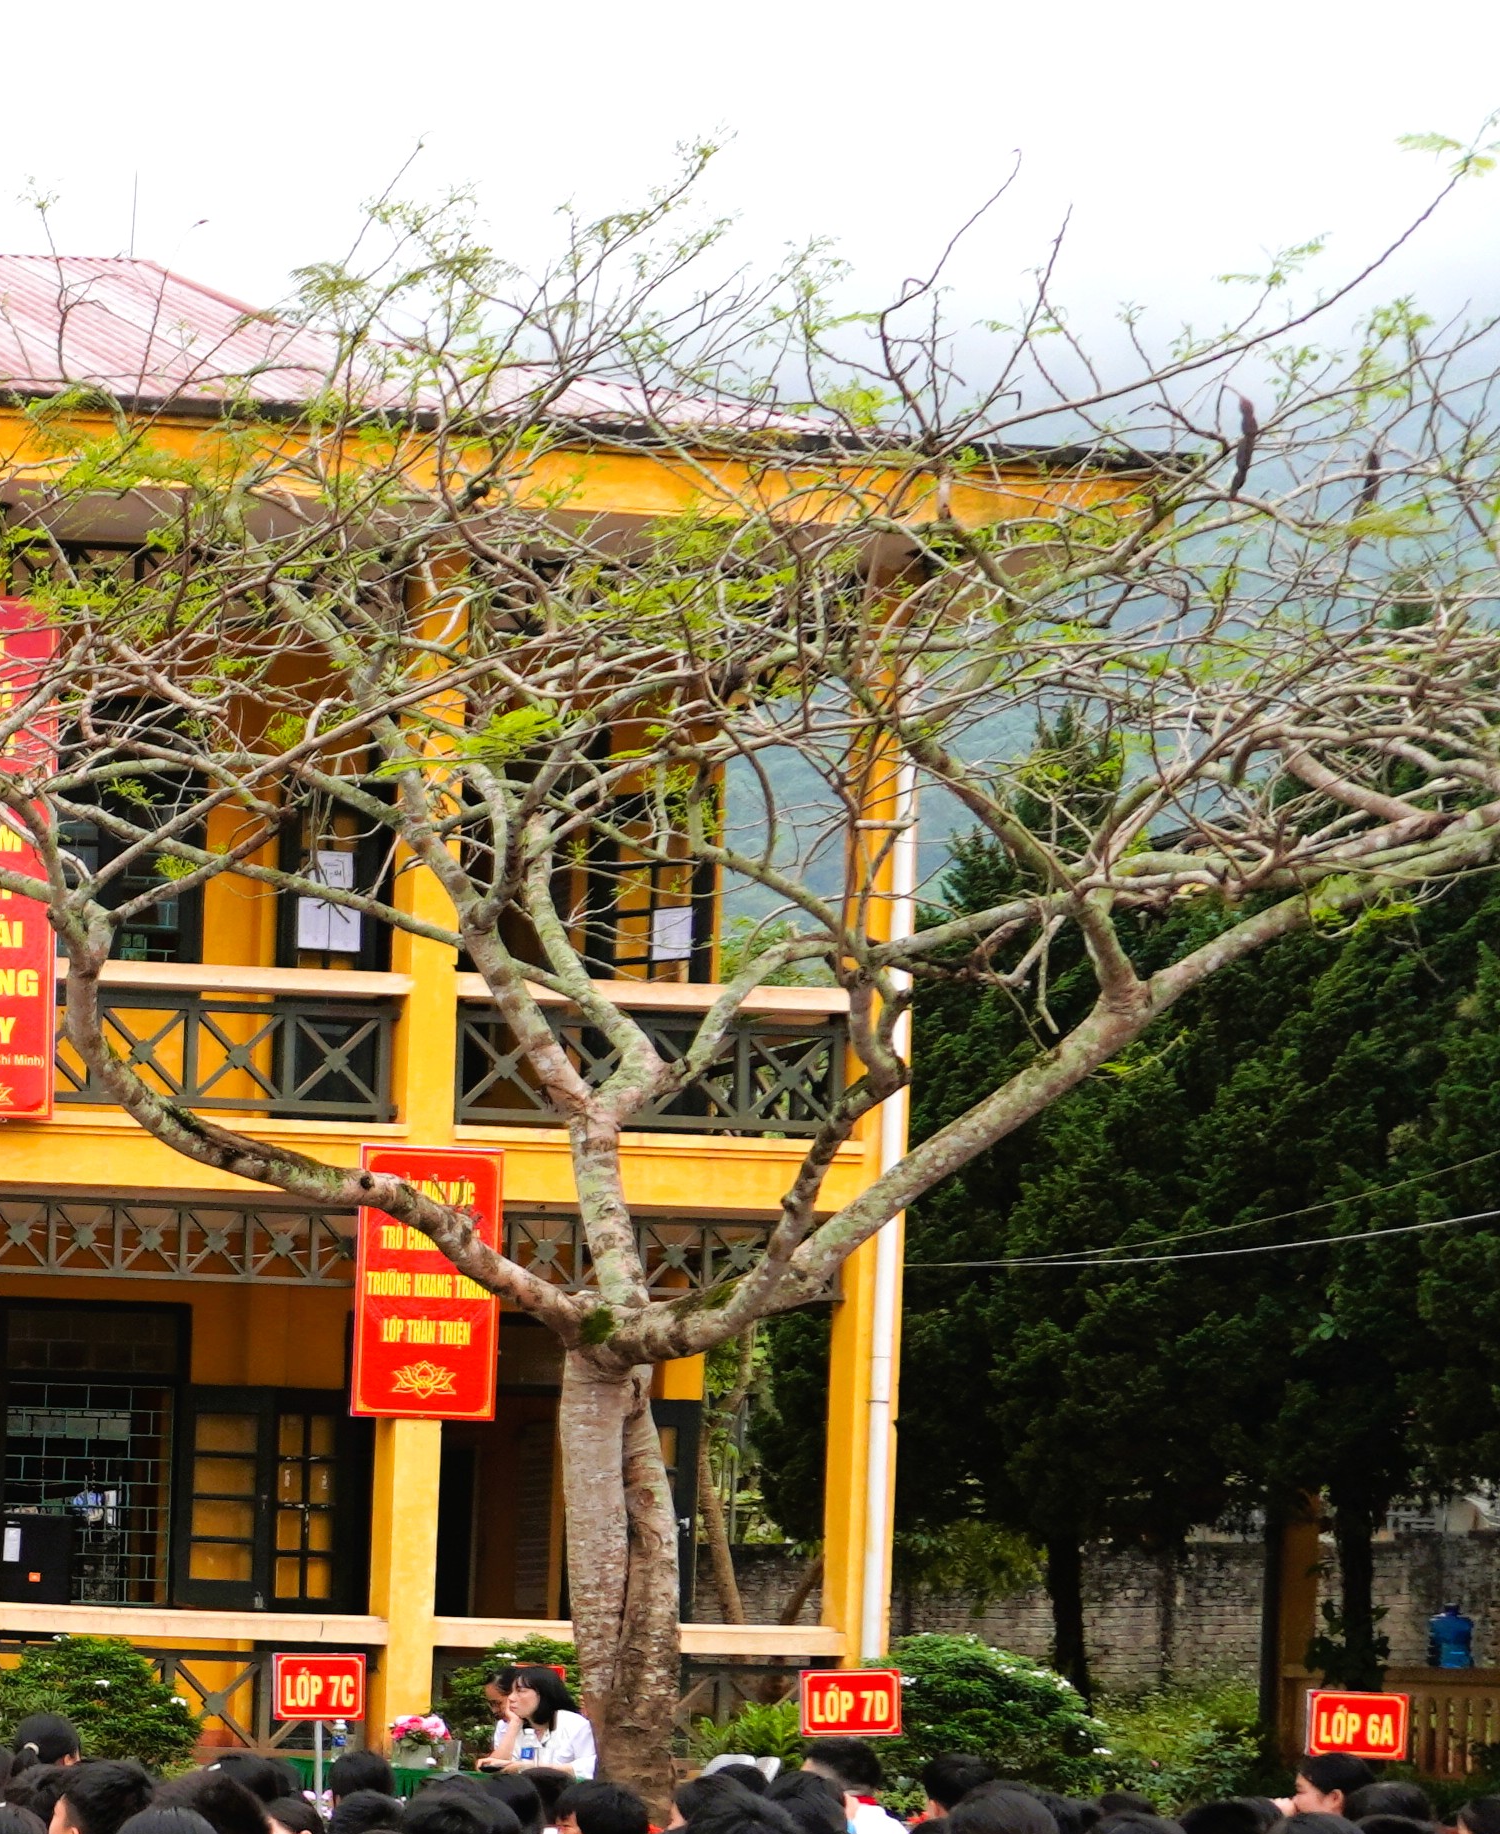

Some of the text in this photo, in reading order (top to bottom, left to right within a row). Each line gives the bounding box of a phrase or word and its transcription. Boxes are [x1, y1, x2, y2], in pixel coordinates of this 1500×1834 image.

[414, 1273, 452, 1298] KHANG
[283, 1667, 355, 1708] LỚP 7C
[812, 1682, 888, 1723] LỚP 7D
[1318, 1705, 1394, 1747] LỚP 6A
